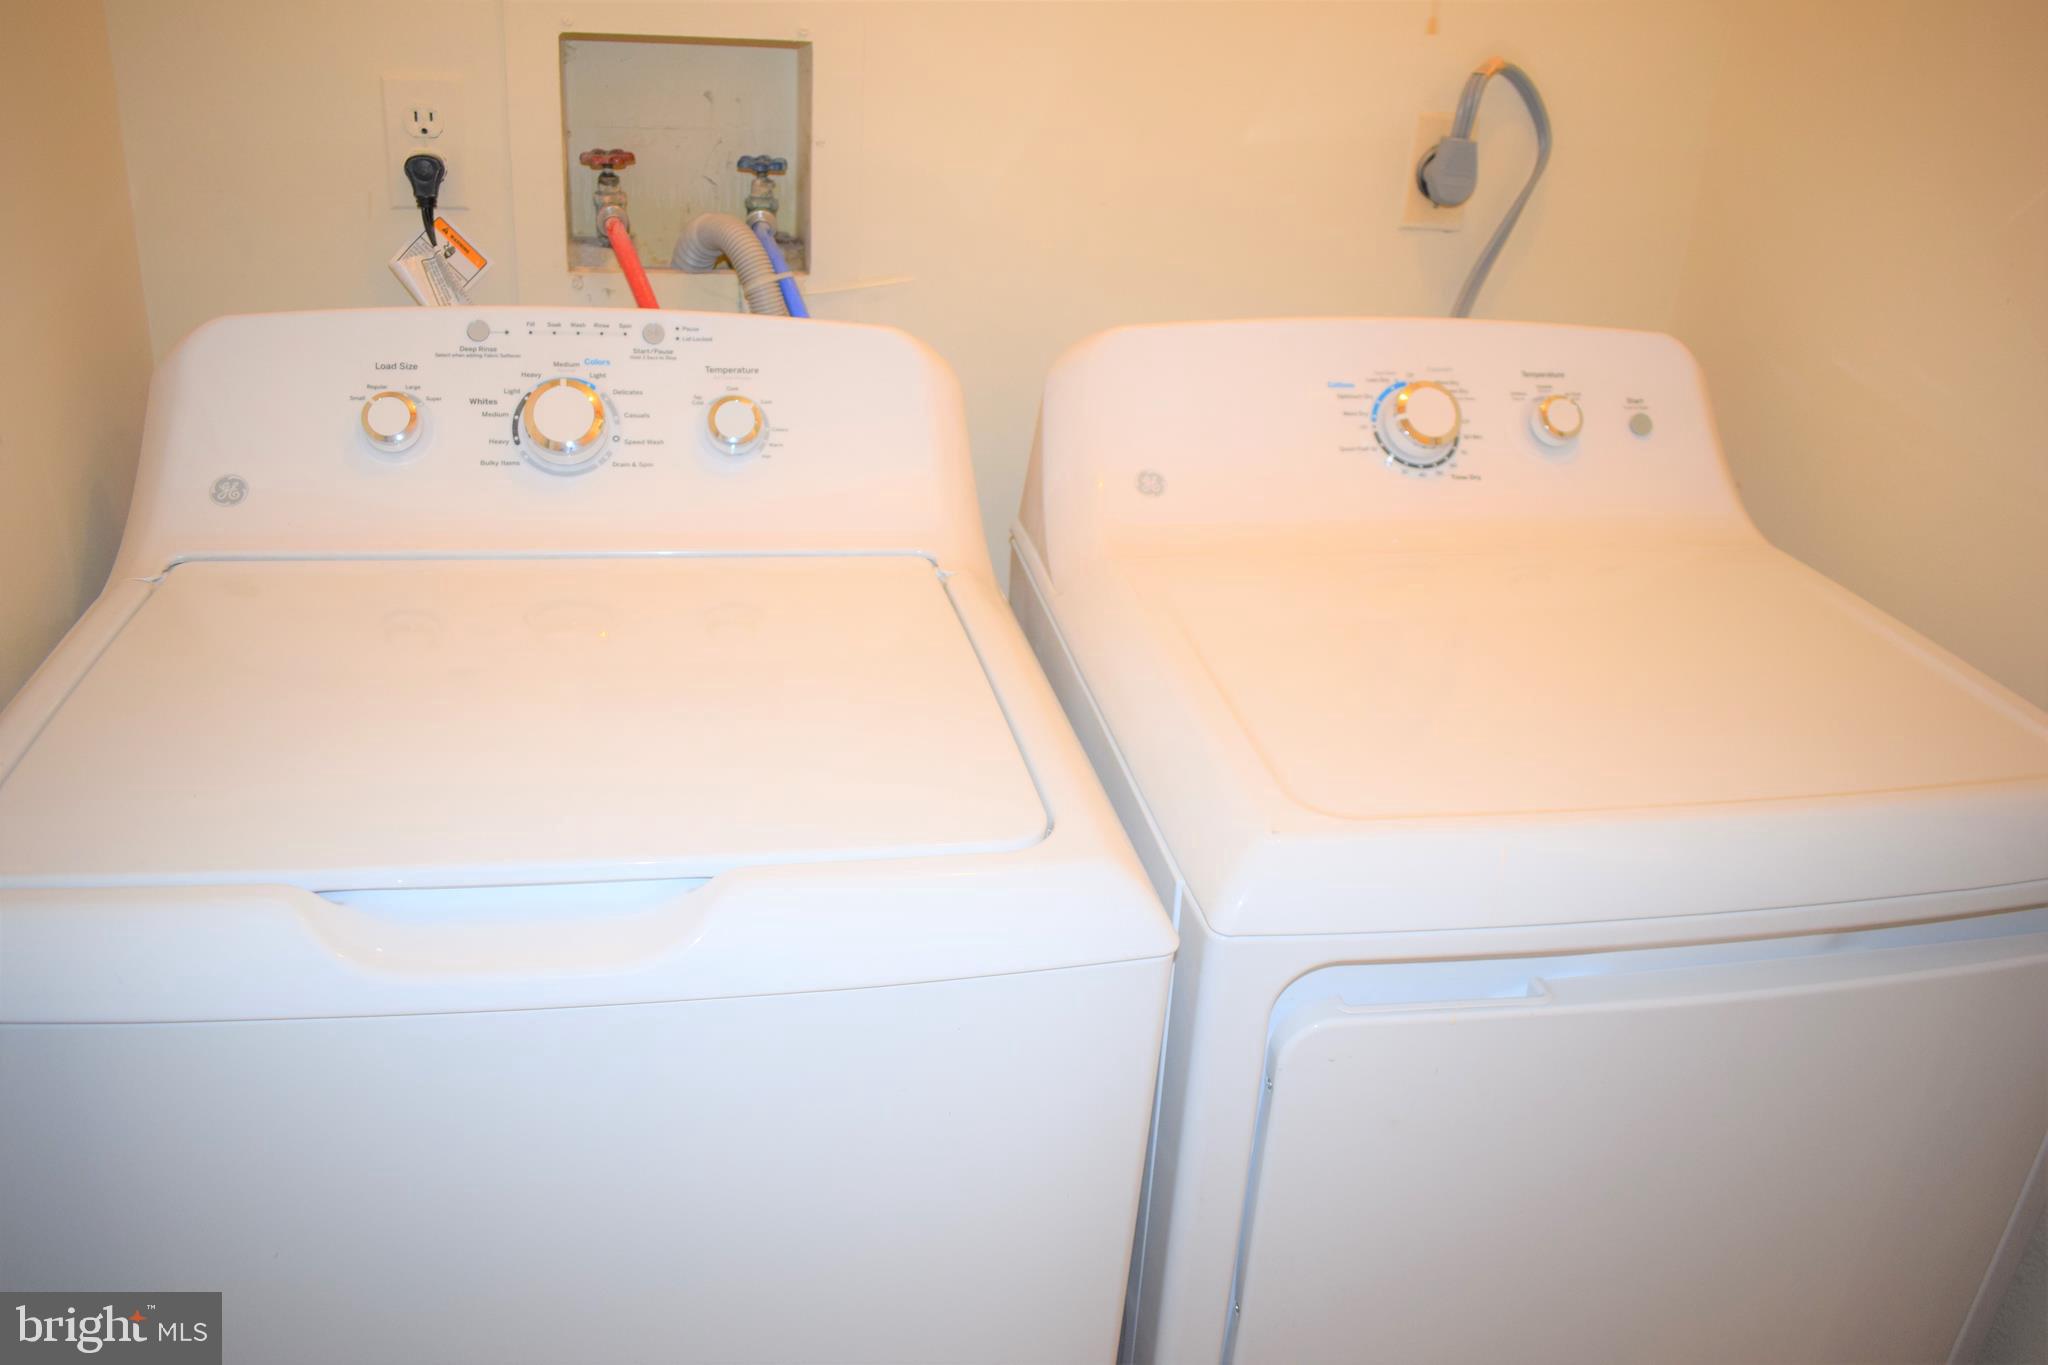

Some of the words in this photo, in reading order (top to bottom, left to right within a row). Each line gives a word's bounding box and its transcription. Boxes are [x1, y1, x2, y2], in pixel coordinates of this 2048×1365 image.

[459, 345, 477, 353] Deep
[478, 345, 498, 353] Rinse
[375, 361, 397, 370] Load
[399, 361, 419, 370] Size
[552, 361, 581, 369] Medium
[584, 357, 611, 367] Colors
[704, 365, 760, 376] Temperature
[520, 371, 542, 380] Heavy
[589, 372, 607, 380] Light
[503, 388, 521, 396] Light
[612, 389, 643, 397] Delicates
[469, 397, 498, 406] Whites
[623, 411, 651, 420] Casuals
[488, 438, 510, 446] Heavy
[624, 438, 646, 447] Speed
[480, 459, 500, 468] Bulky
[500, 459, 521, 467] Items
[611, 461, 630, 469] Drain
